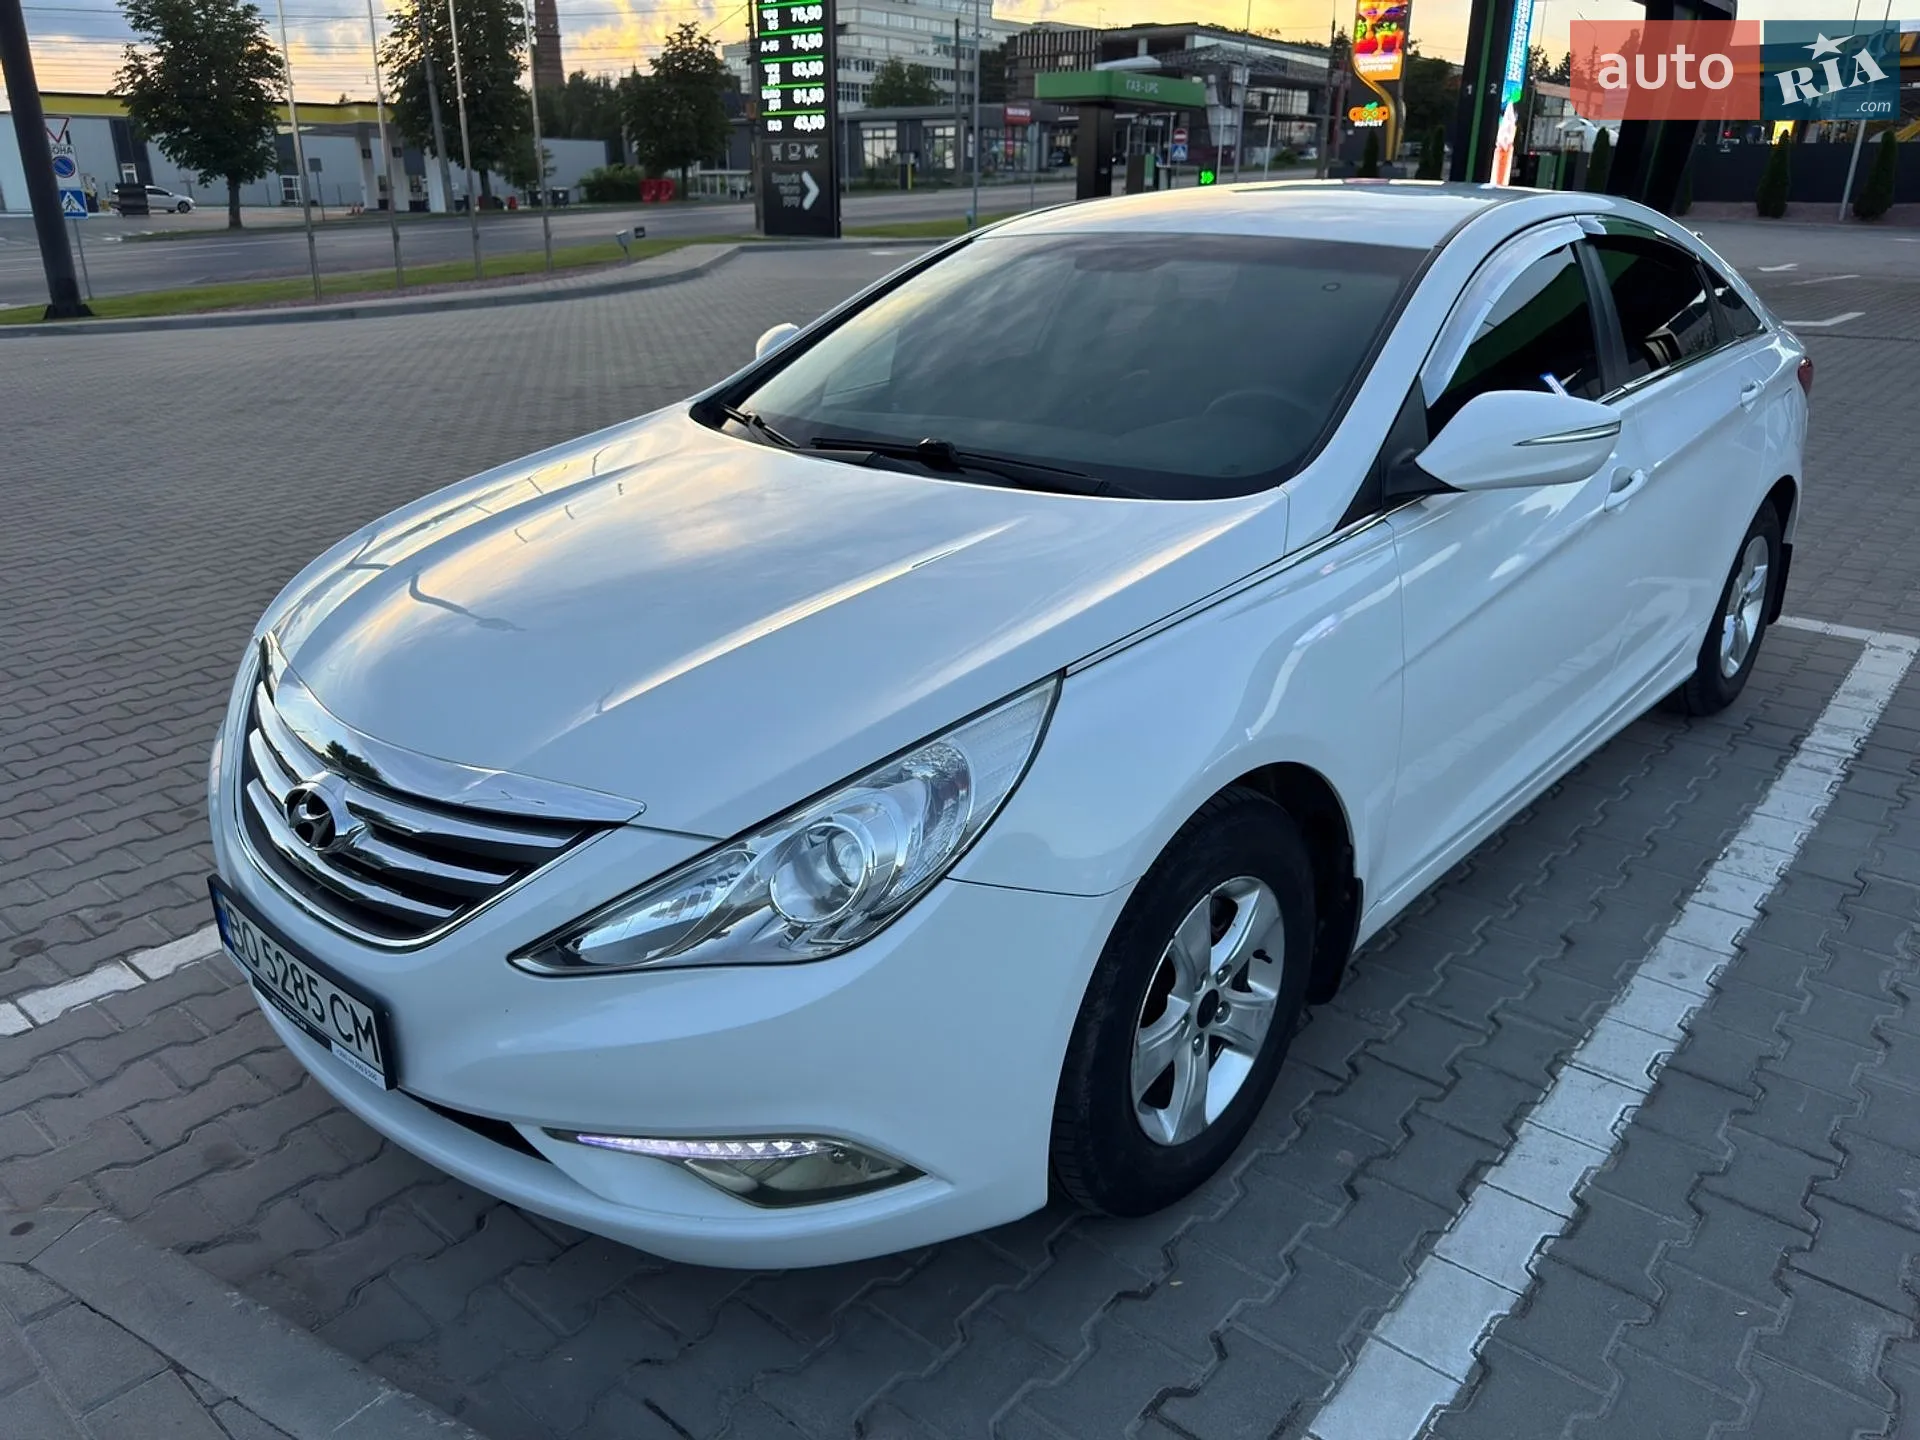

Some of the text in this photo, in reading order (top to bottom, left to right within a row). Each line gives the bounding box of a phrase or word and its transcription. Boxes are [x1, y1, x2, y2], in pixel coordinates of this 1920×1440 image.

[1467, 84, 1473, 95] 1
[1490, 83, 1498, 94] 2
[261, 938, 326, 1023] 5285
[329, 993, 381, 1063] CM
